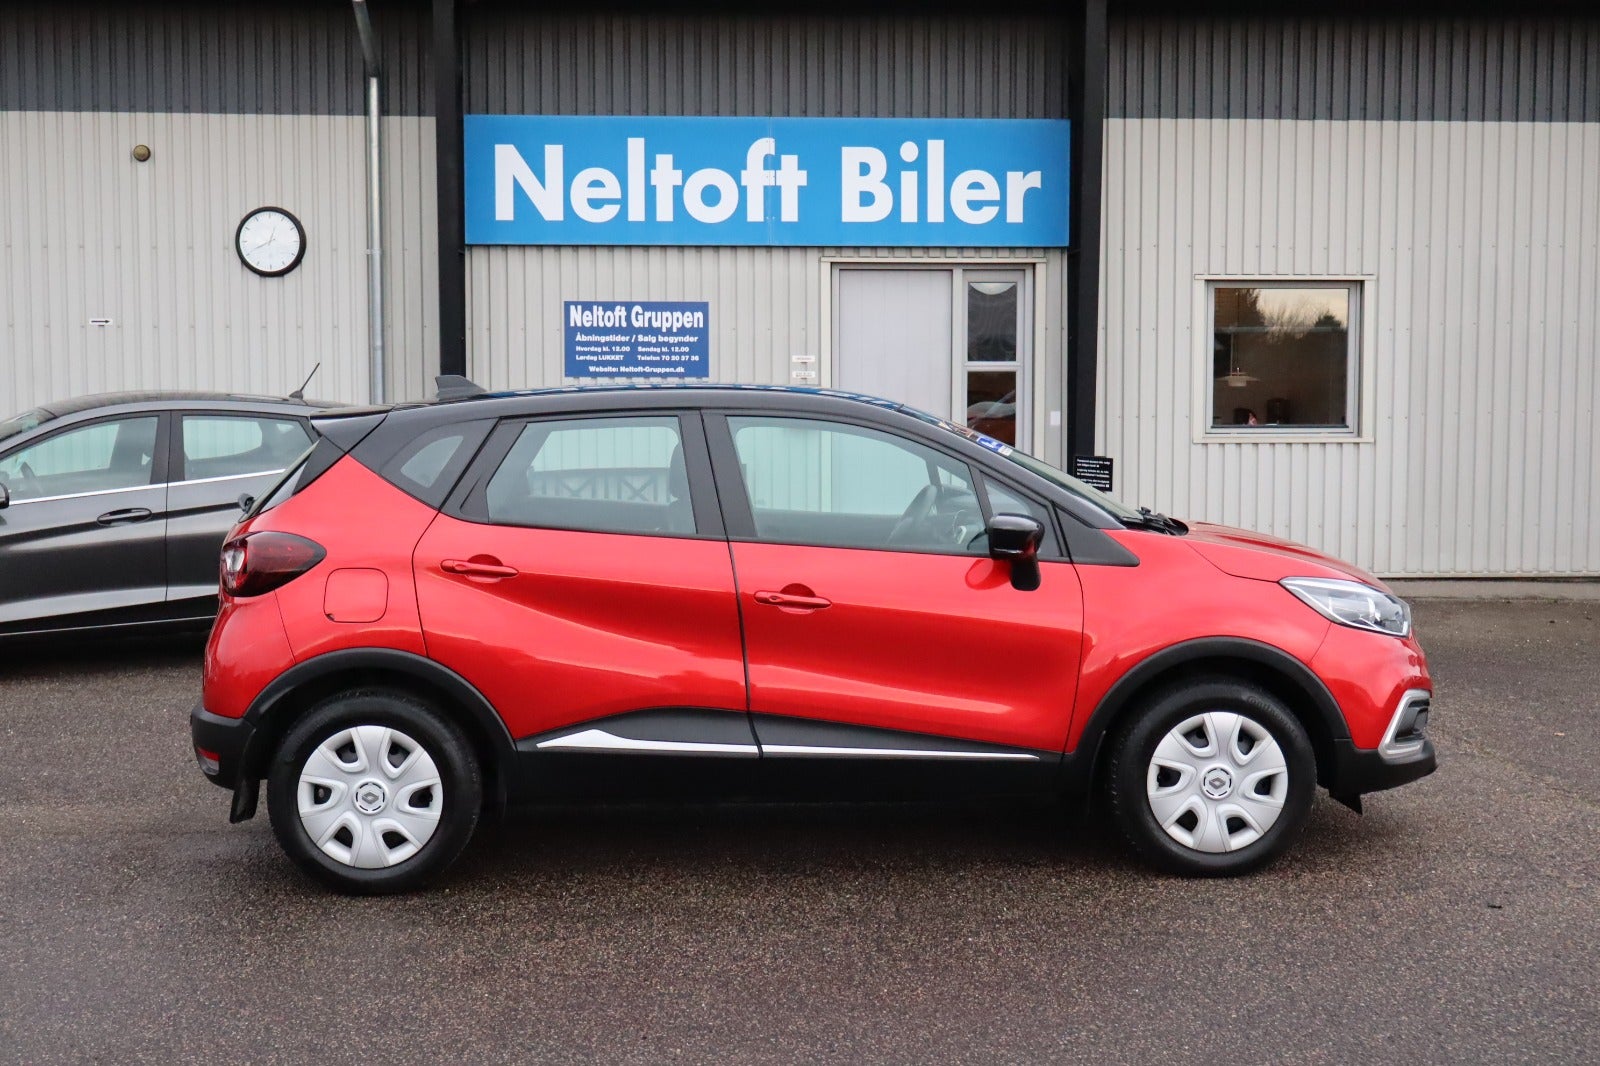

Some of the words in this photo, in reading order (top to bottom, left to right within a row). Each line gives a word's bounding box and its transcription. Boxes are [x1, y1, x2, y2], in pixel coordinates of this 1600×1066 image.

[494, 137, 808, 224] Neltoft
[841, 139, 1042, 225] Biler
[570, 305, 627, 327] Neltoft
[631, 305, 703, 332] Gruppen
[575, 332, 630, 343] Åbningstider
[631, 334, 636, 342] /
[637, 334, 657, 343] Salg
[658, 334, 698, 343] begynder
